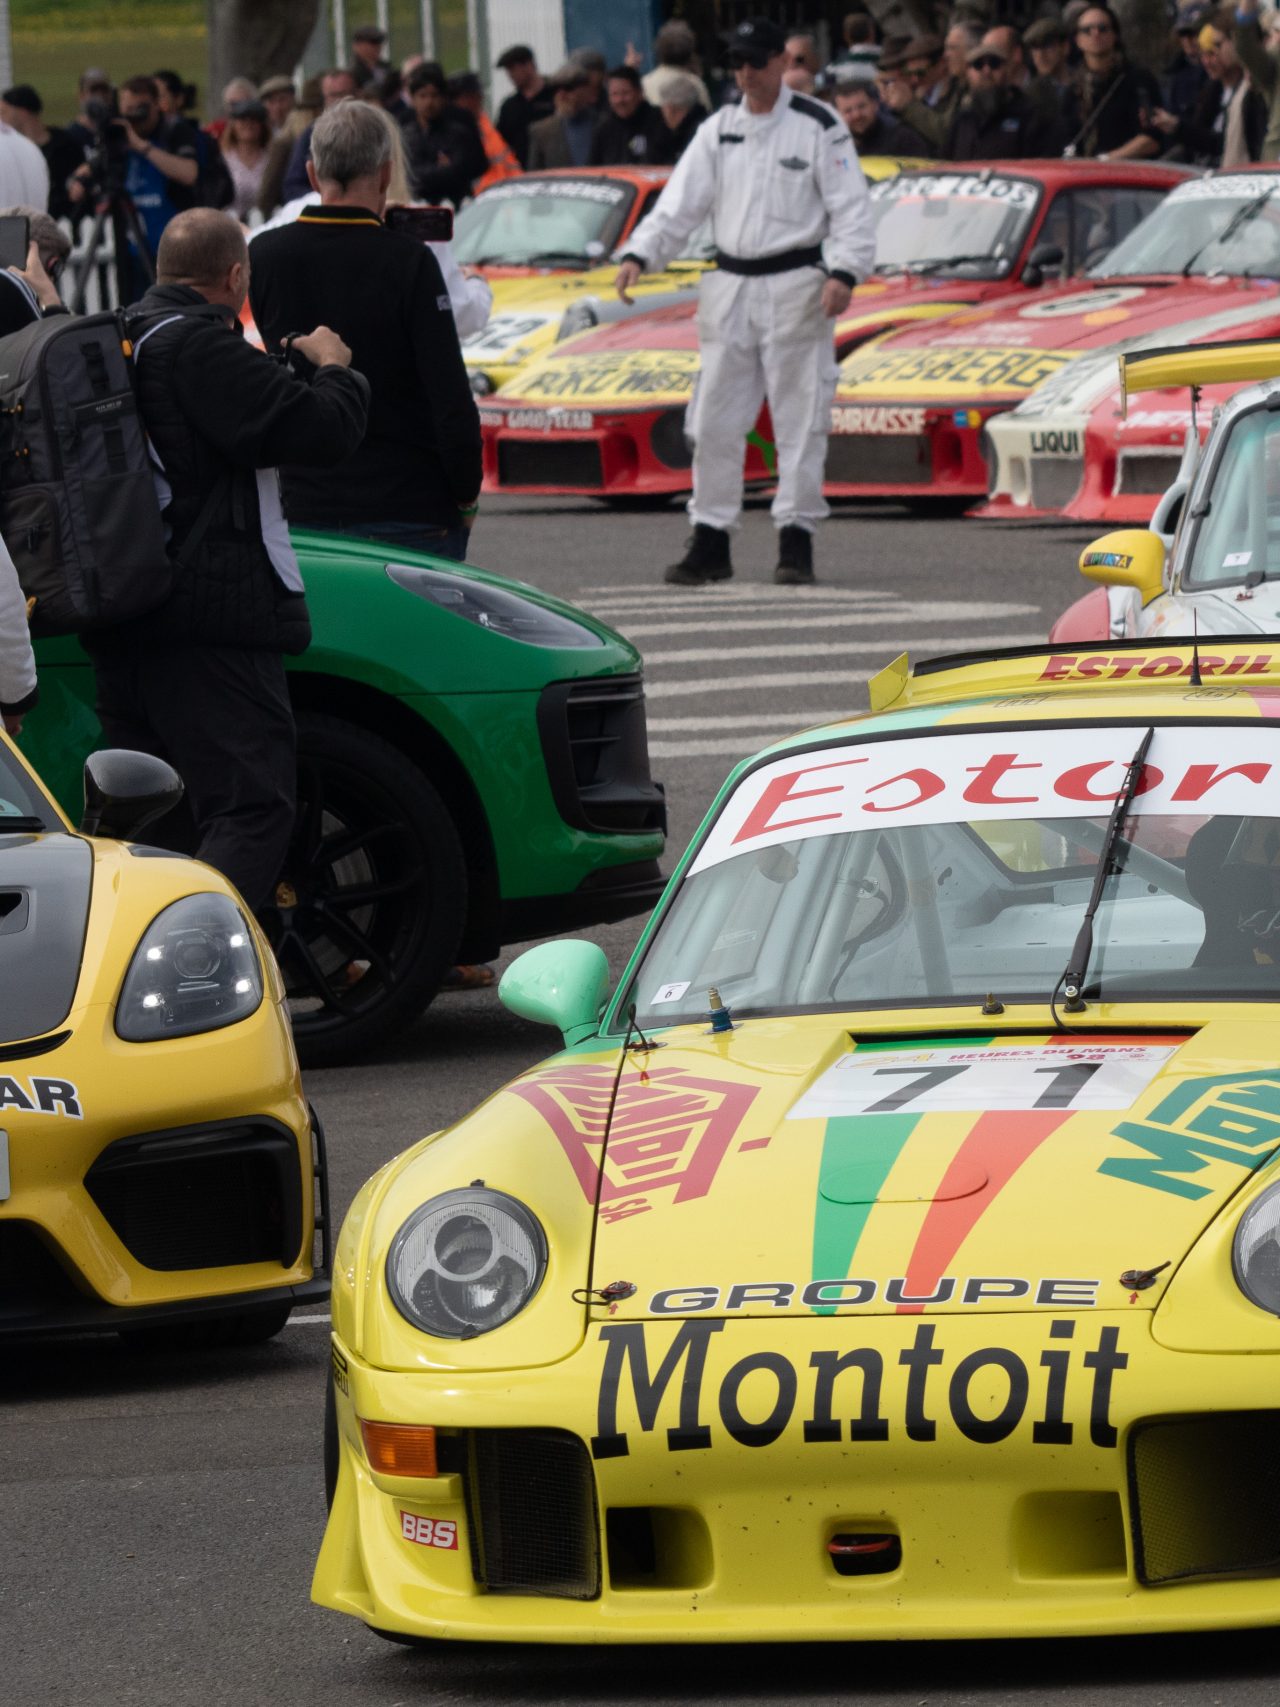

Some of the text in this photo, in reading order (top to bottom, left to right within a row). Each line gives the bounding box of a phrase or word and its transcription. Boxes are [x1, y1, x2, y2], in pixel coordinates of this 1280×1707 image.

[1030, 431, 1079, 453] LIQUI
[1038, 654, 1273, 681] ESTORIL
[950, 1050, 1036, 1060] HEURES
[1042, 1048, 1076, 1056] DU
[1080, 1046, 1148, 1054] MANS
[1066, 1053, 1105, 1061] 98
[648, 1276, 1100, 1315] GROUPE
[590, 1318, 1129, 1459] Montoit
[402, 1512, 456, 1548] BBS
